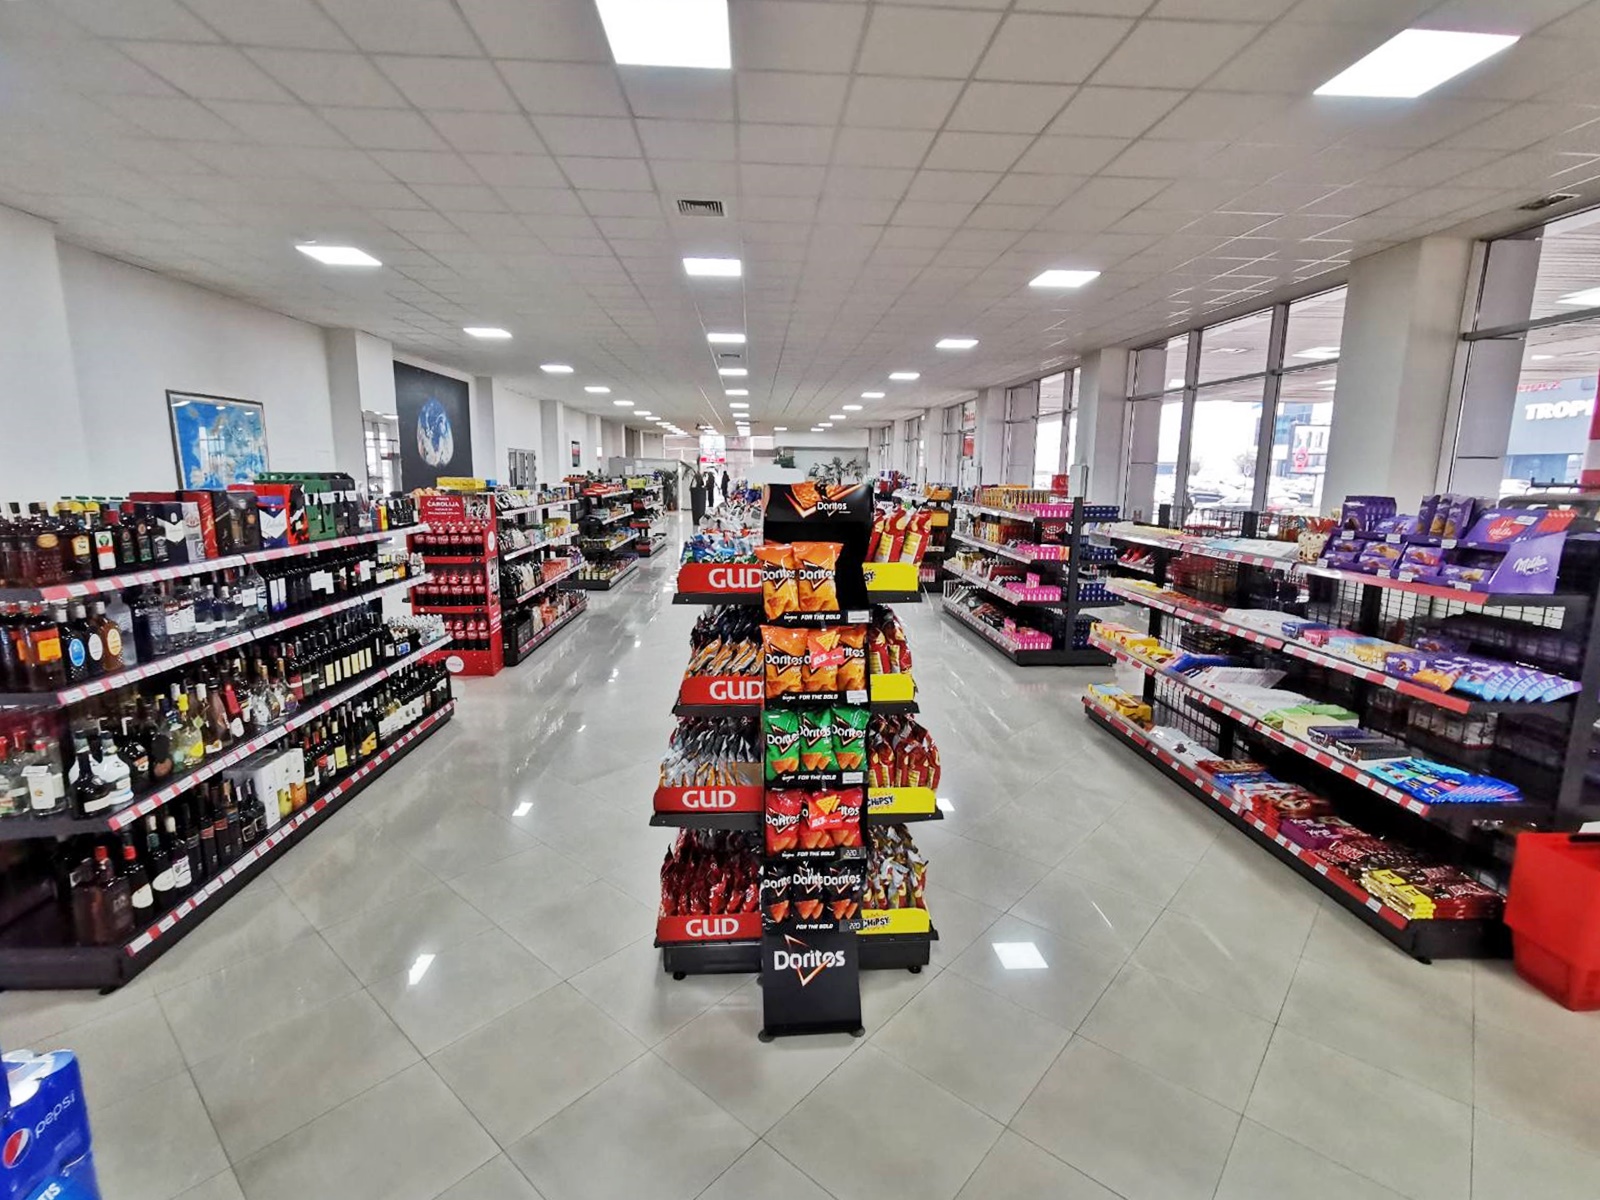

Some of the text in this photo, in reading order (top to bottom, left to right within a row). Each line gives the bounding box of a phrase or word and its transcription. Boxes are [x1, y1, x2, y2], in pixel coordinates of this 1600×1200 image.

[817, 501, 847, 511] Doritos
[1513, 556, 1548, 573] Milka
[708, 568, 762, 589] GUD
[765, 653, 802, 665] Doritos
[709, 680, 764, 700] GUD
[682, 789, 737, 809] GUD
[763, 875, 791, 889] Dorito
[823, 873, 860, 886] Doritos
[685, 917, 739, 937] GUD
[774, 950, 846, 971] Doritos
[35, 1089, 76, 1139] pepsi
